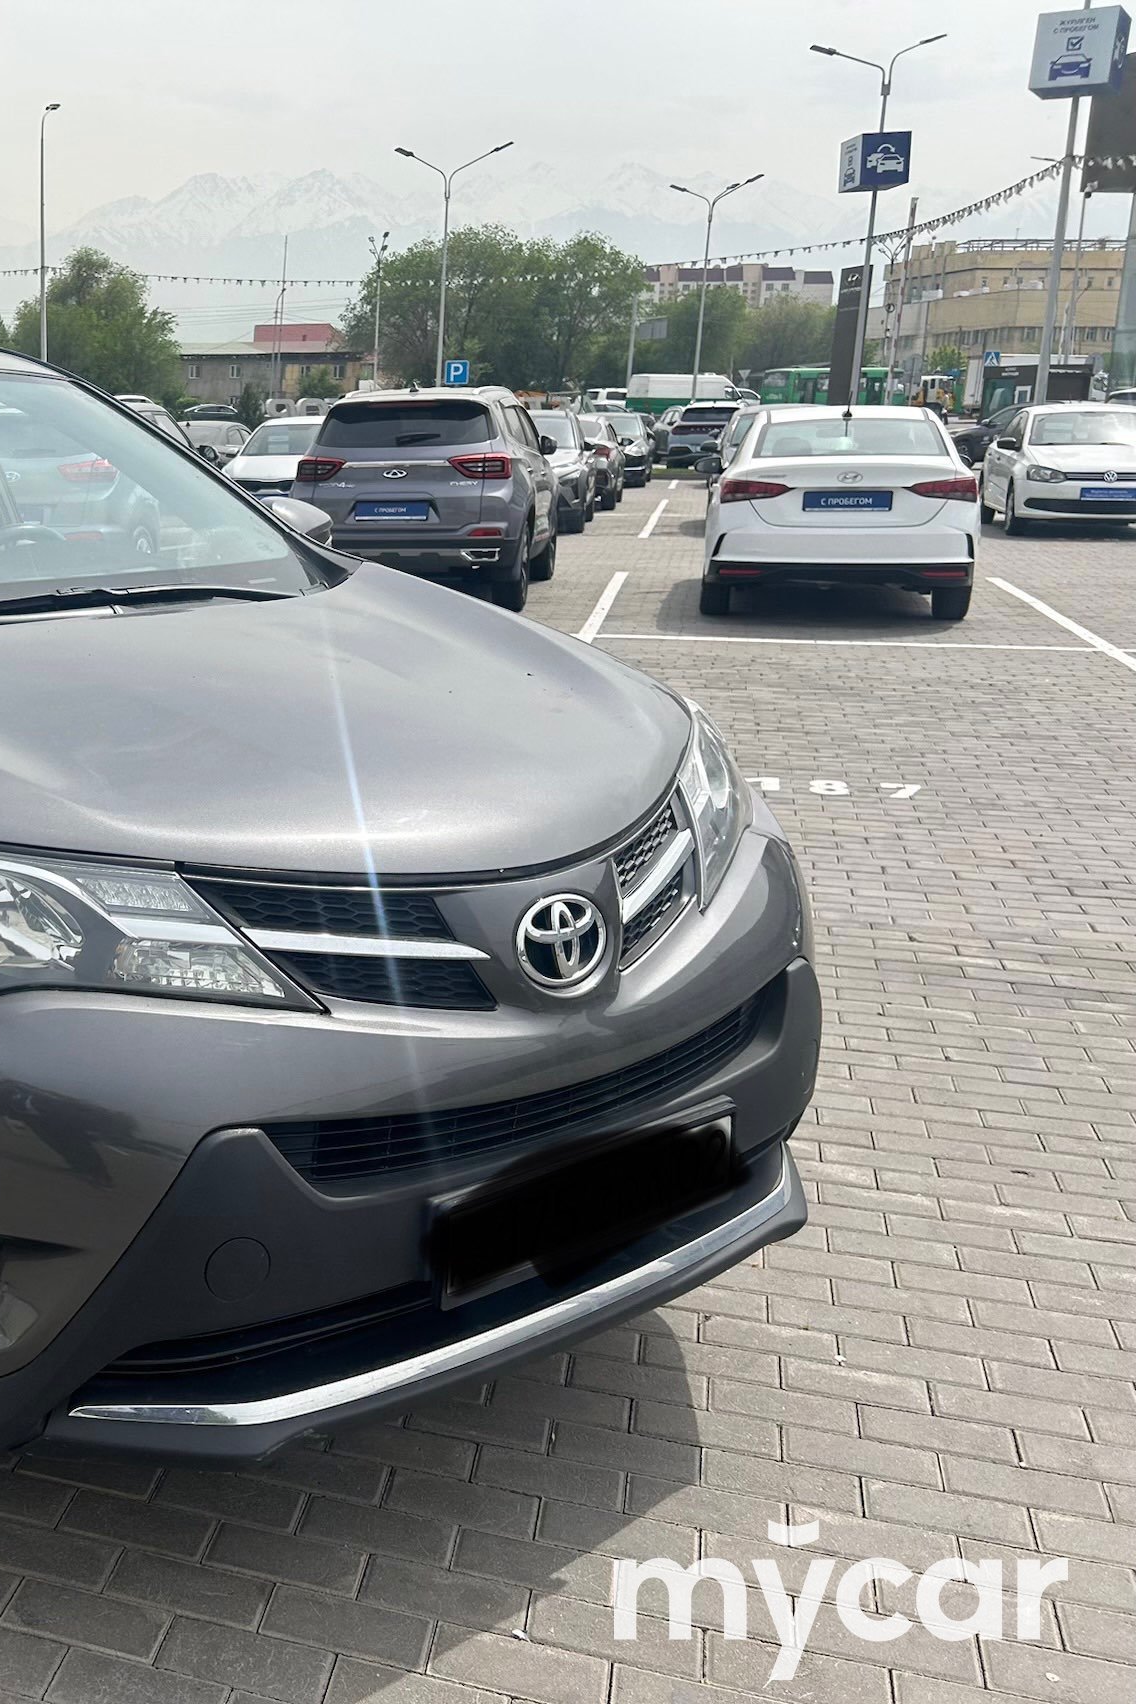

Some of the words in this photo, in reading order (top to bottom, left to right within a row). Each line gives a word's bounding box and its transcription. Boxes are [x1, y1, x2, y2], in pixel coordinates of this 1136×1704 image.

[450, 364, 463, 382] P
[821, 497, 827, 506] С
[828, 497, 873, 506] ПРОБЕГОМ
[378, 506, 407, 514] ПРОБЕГОМ
